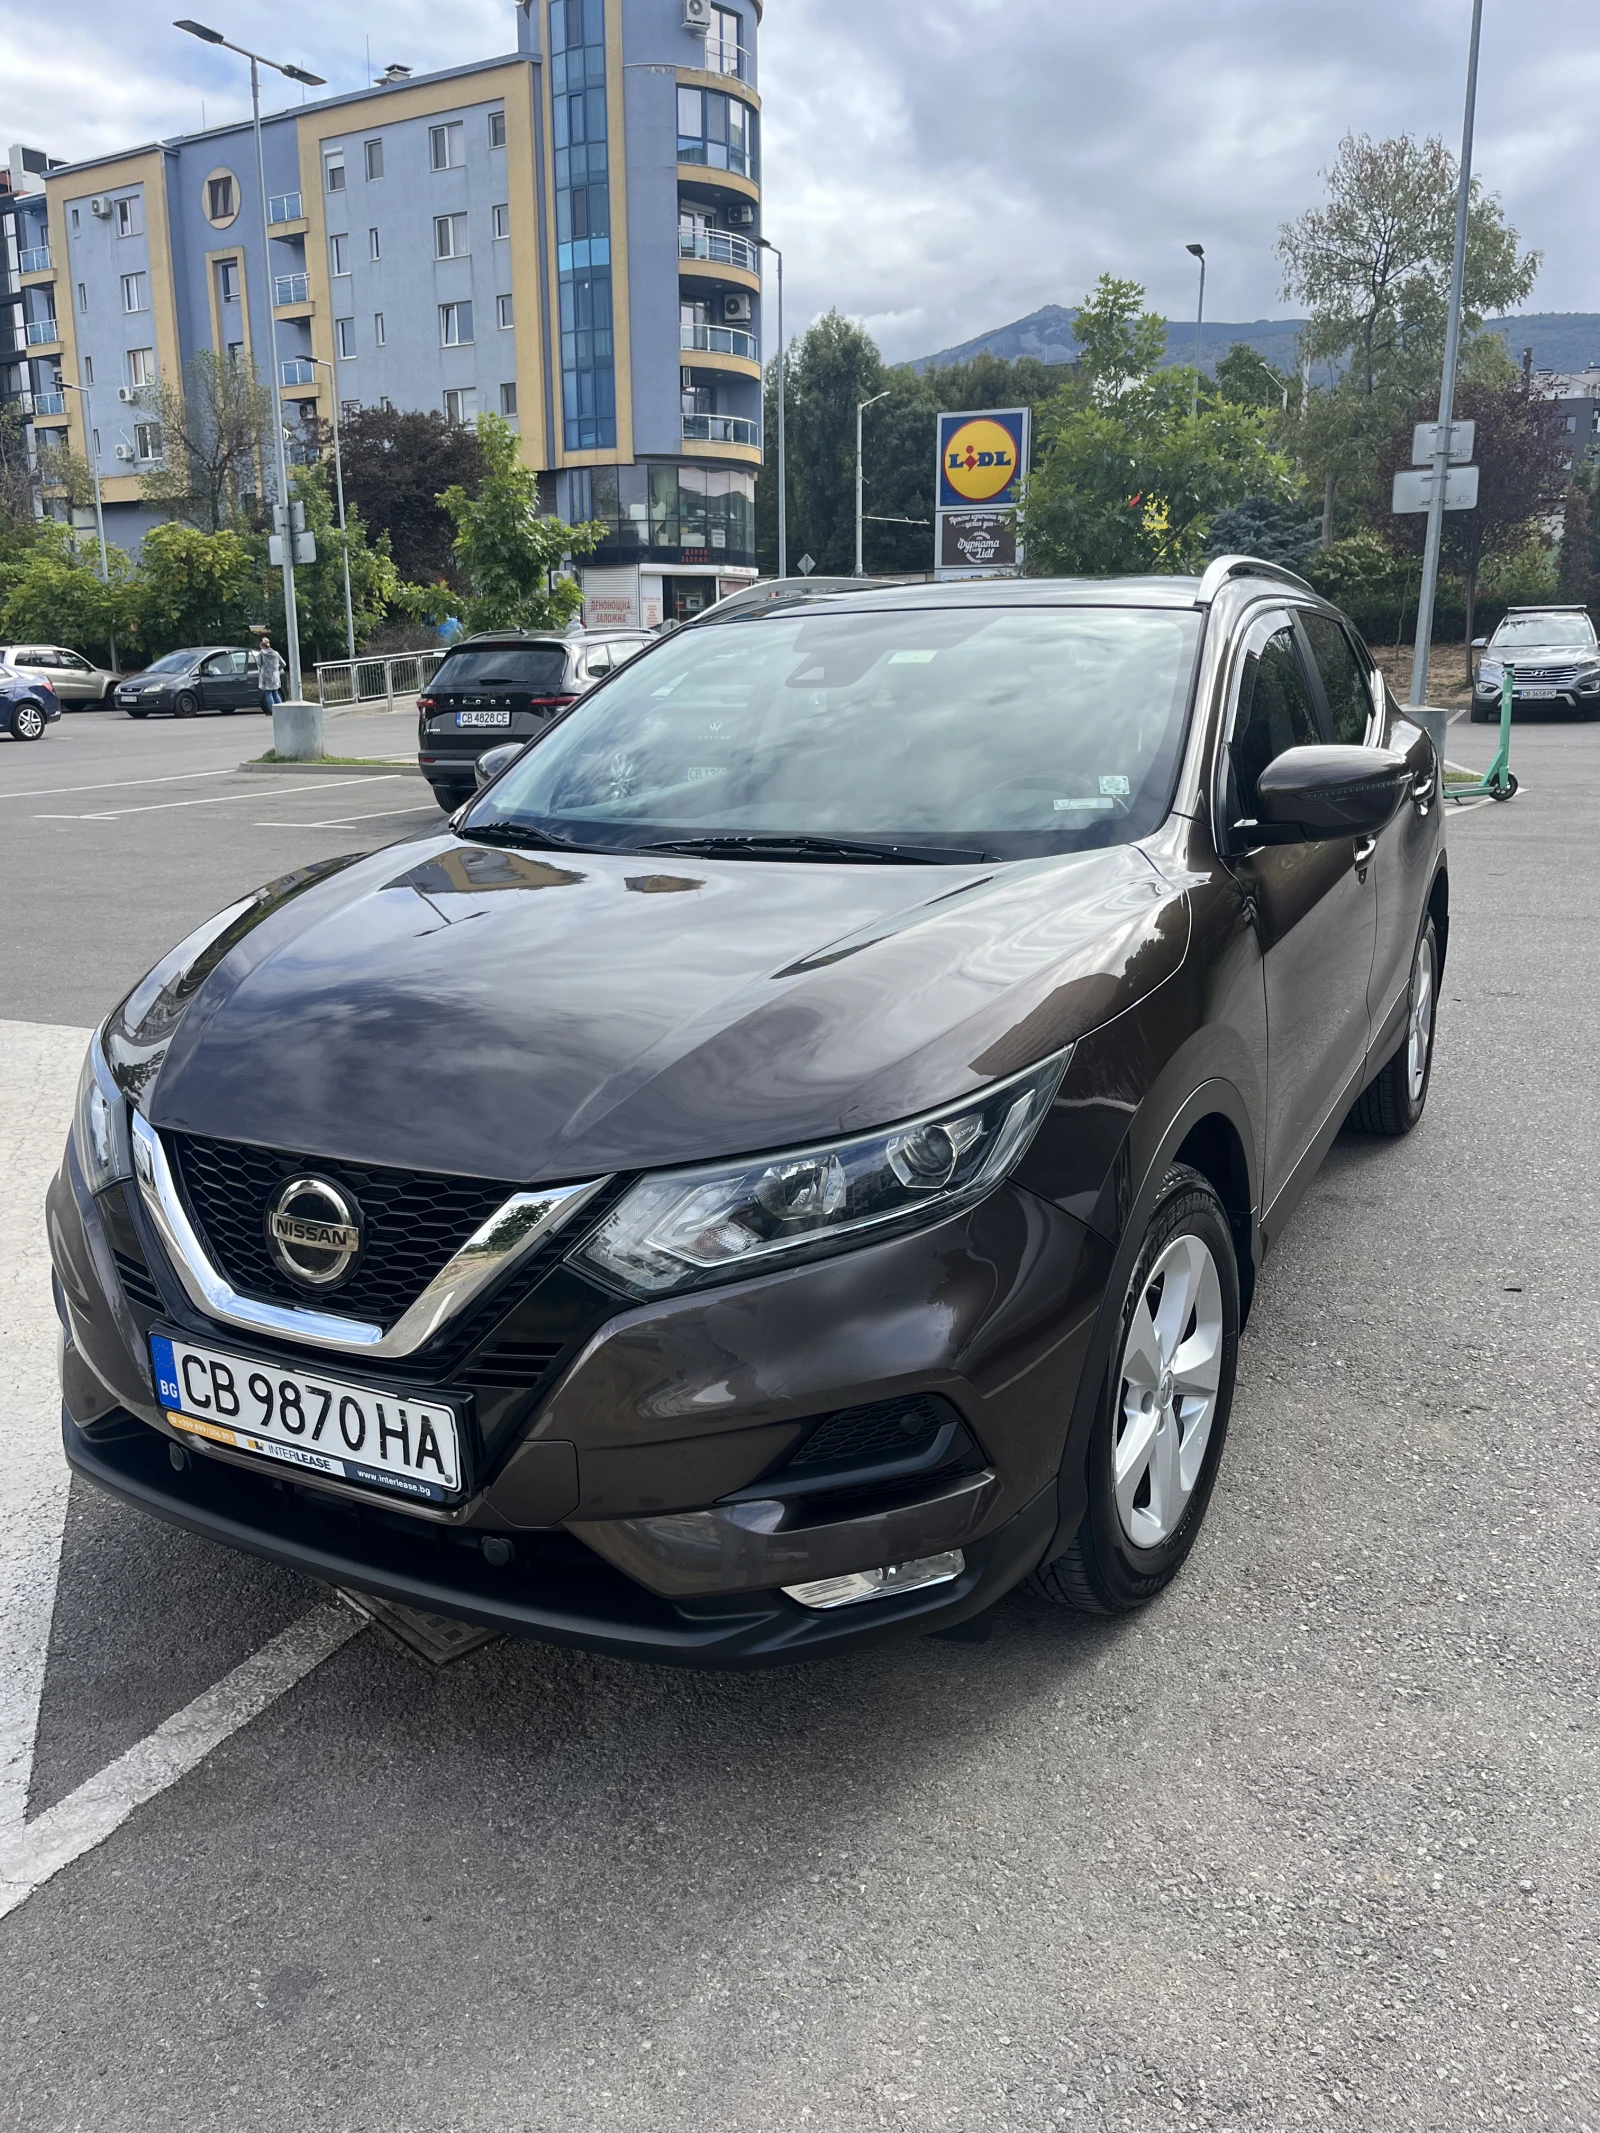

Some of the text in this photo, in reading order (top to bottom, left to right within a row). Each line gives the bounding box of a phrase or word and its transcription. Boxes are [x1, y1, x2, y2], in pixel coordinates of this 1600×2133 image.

[957, 538, 1000, 553] Фурната
[976, 547, 995, 558] Lidl
[591, 600, 631, 611] ДЕНОНОЩНА
[596, 614, 627, 623] ЗАЛОЖНА
[474, 713, 495, 723] 4828
[276, 1218, 347, 1246] NISSAN
[159, 1379, 180, 1399] BG
[181, 1354, 447, 1476] CB 9870 HA
[268, 1444, 331, 1472] INTERLEASE
[357, 1468, 431, 1496] www.interlease.bg
